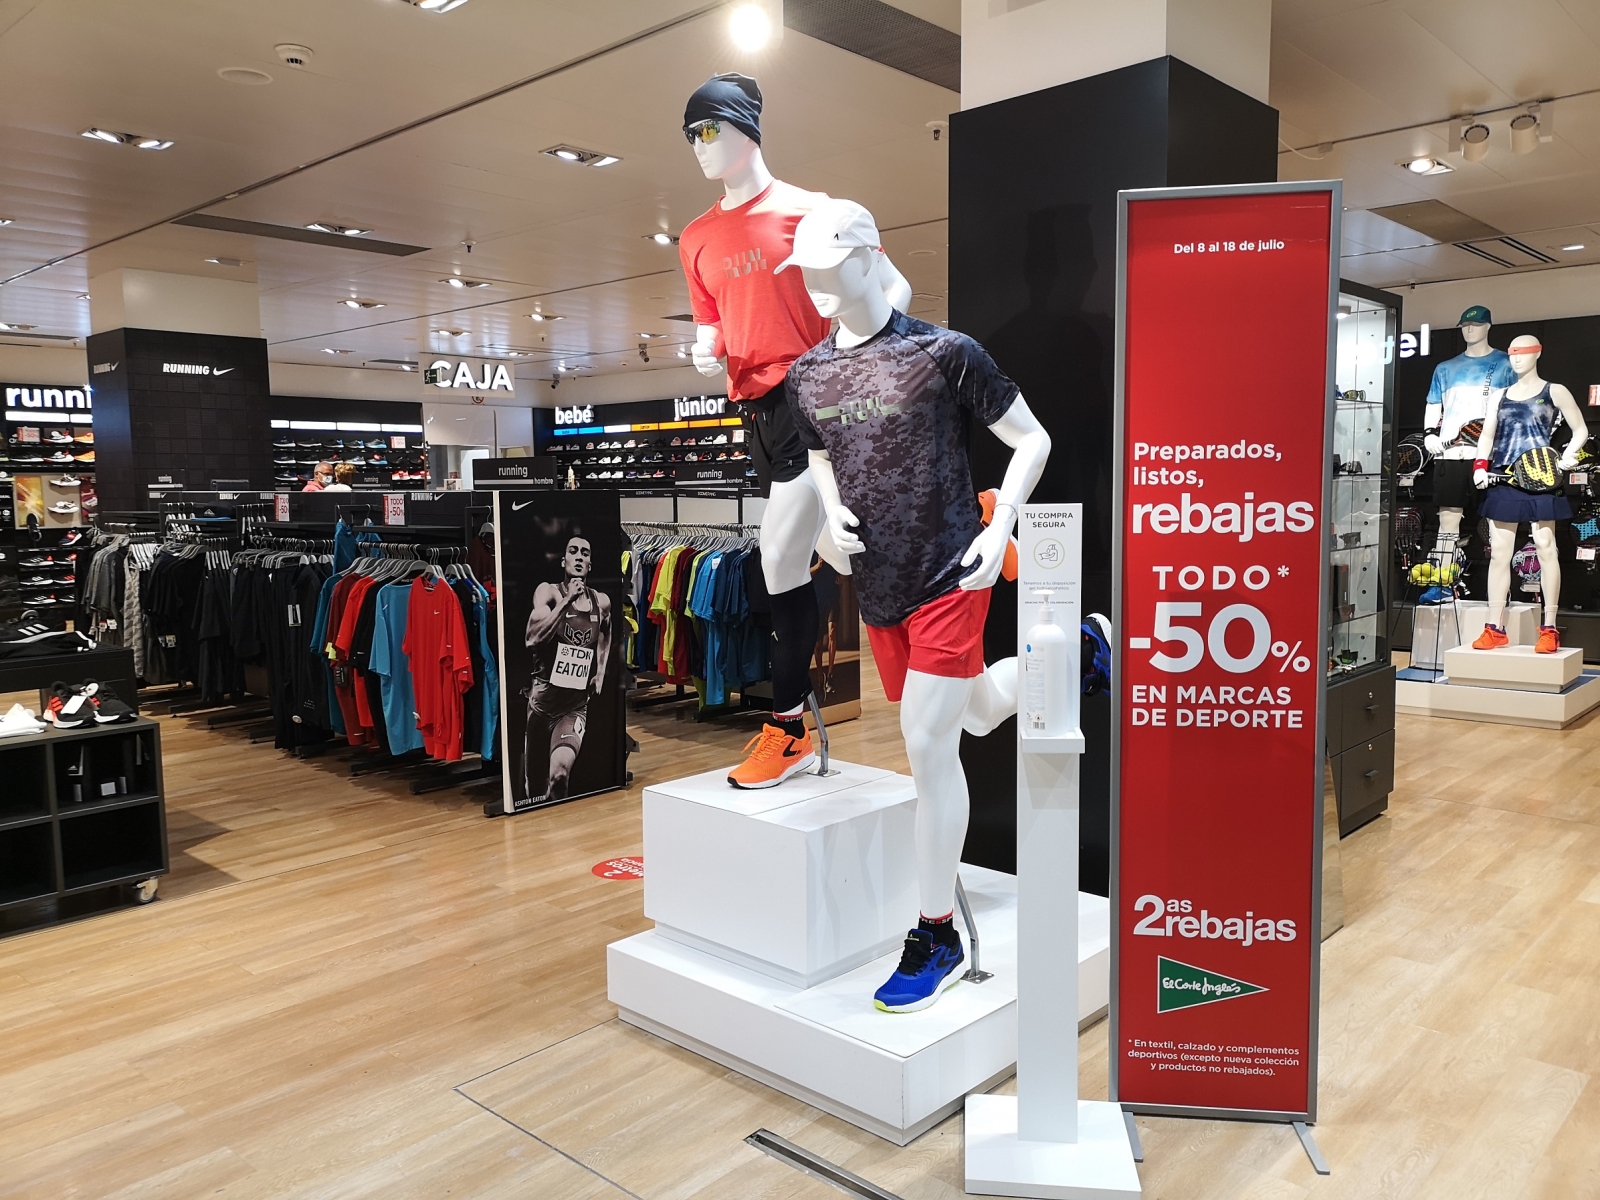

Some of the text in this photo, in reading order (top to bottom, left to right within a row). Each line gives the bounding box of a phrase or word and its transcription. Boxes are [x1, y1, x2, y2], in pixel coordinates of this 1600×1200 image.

[1173, 239, 1285, 254] Del 8 al 18 de julio
[162, 363, 210, 375] RUNNING
[430, 360, 514, 391] CAJA
[554, 404, 594, 425] bebé
[674, 396, 726, 421] júnior
[1134, 439, 1282, 464] Preparados,
[498, 464, 528, 477] running
[696, 469, 723, 479] running
[1133, 466, 1204, 488] listos,
[534, 477, 554, 485] hombre
[726, 477, 744, 485] hombre
[1132, 492, 1315, 543] rebajas
[564, 622, 592, 646] USA
[1129, 601, 1312, 675] -50%
[570, 648, 591, 660] TDK
[556, 661, 589, 678] EATON
[1132, 685, 1292, 705] EN MARCAS
[1132, 708, 1303, 729] DE DEPORTE
[1166, 909, 1297, 946] rebajas
[1162, 976, 1242, 996] El Corte Inglés
[1134, 1039, 1147, 1047] En
[1149, 1040, 1176, 1050] textil,
[1178, 1042, 1216, 1052] calzado
[1218, 1045, 1224, 1053] y
[1226, 1045, 1300, 1056] complementos
[1128, 1050, 1300, 1066] deportivos (excepto nueva colección
[1150, 1062, 1276, 1077] y productos no rebajados).
